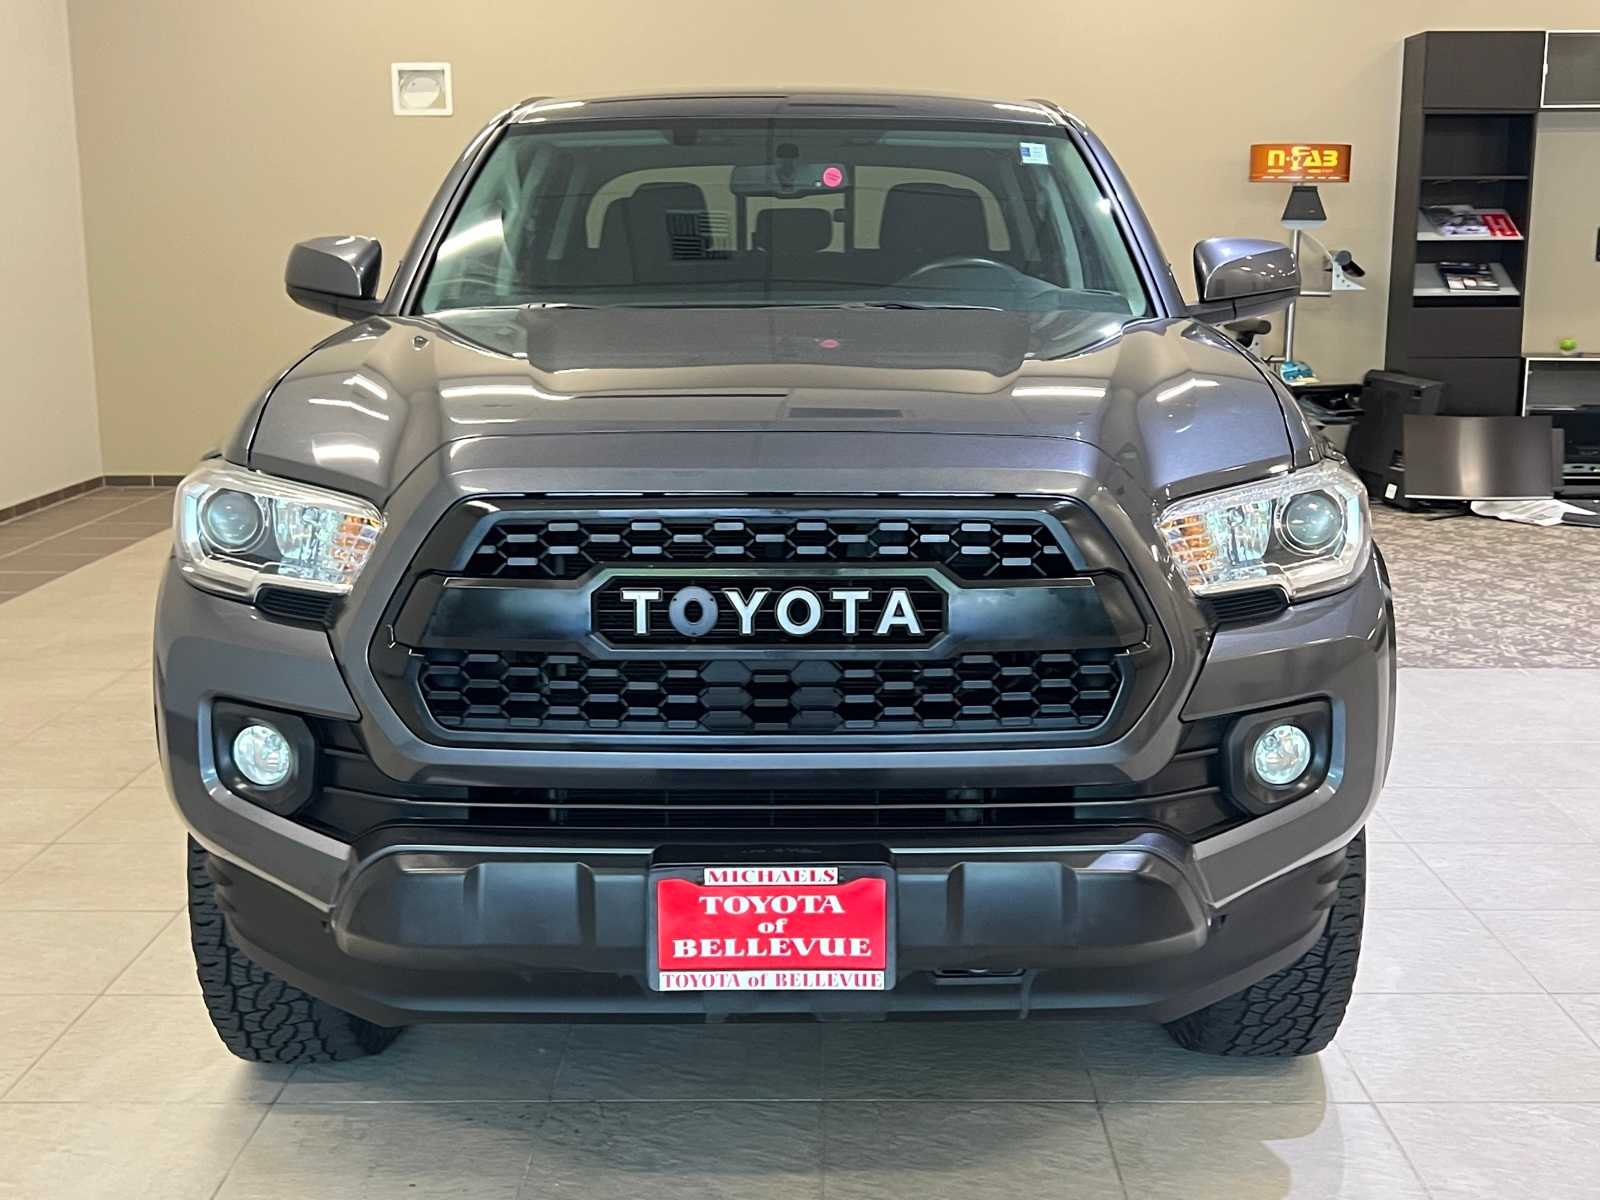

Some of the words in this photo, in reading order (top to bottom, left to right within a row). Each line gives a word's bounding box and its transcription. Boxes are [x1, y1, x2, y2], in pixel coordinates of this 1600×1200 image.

[620, 586, 924, 637] TOYOTA
[708, 869, 835, 882] MICHAELS
[699, 895, 845, 915] TOYOTA
[757, 918, 788, 934] of
[672, 938, 872, 958] BELLEVUE
[661, 973, 741, 988] TOYOTA
[748, 972, 768, 988] of
[775, 972, 883, 988] BELLEVUE
